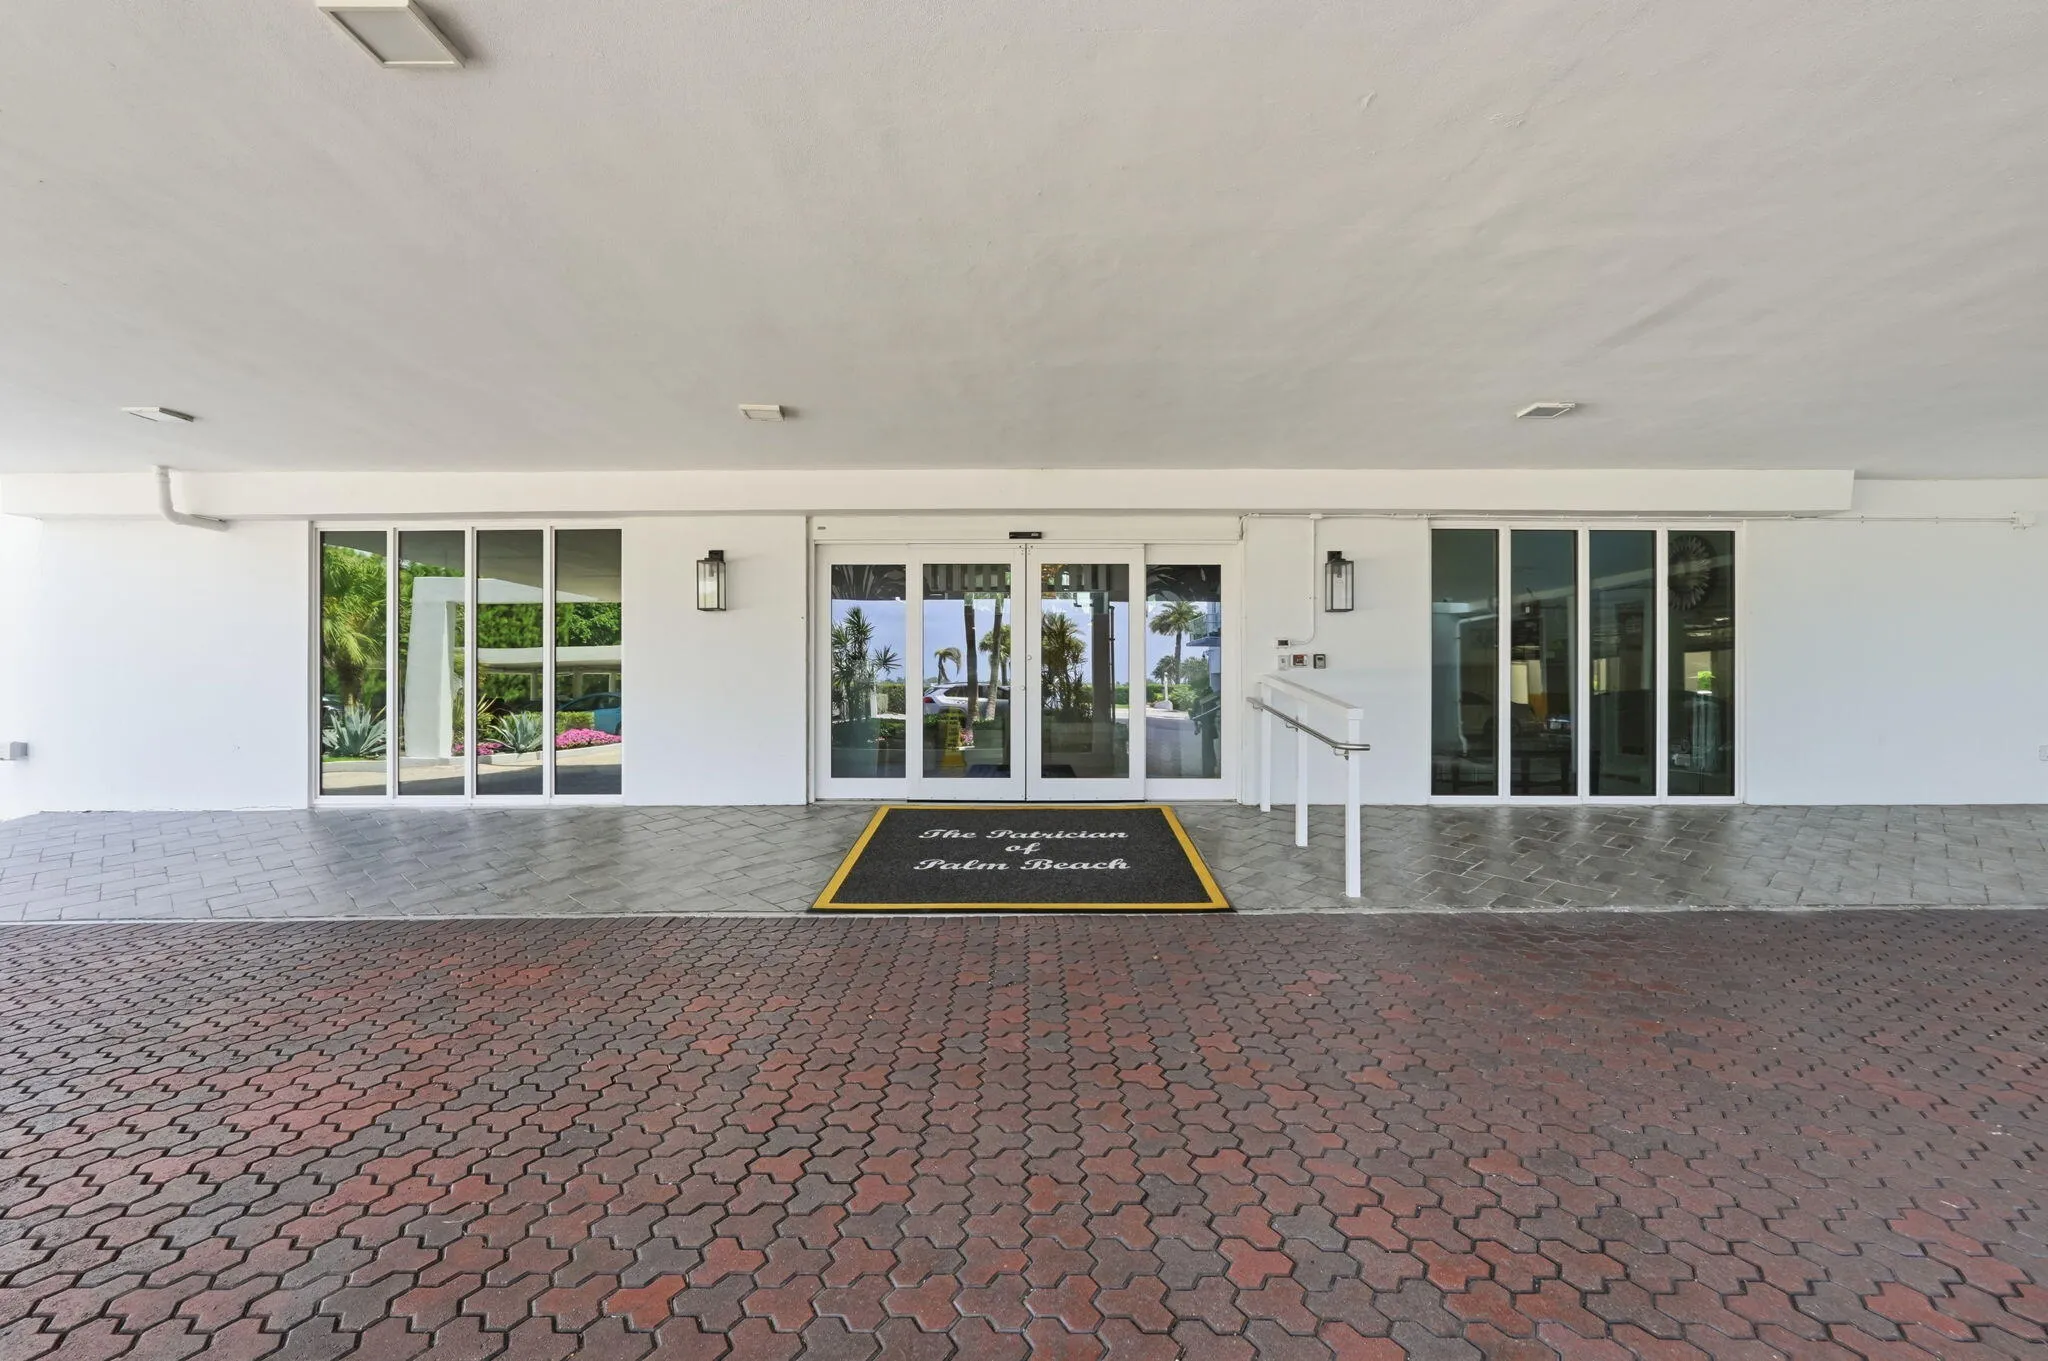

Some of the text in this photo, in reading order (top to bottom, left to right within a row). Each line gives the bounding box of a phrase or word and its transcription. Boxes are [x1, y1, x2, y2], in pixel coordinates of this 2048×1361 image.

[918, 828, 1129, 839] The Patrician
[1005, 842, 1041, 854] of
[913, 857, 1131, 870] Palm Beach
